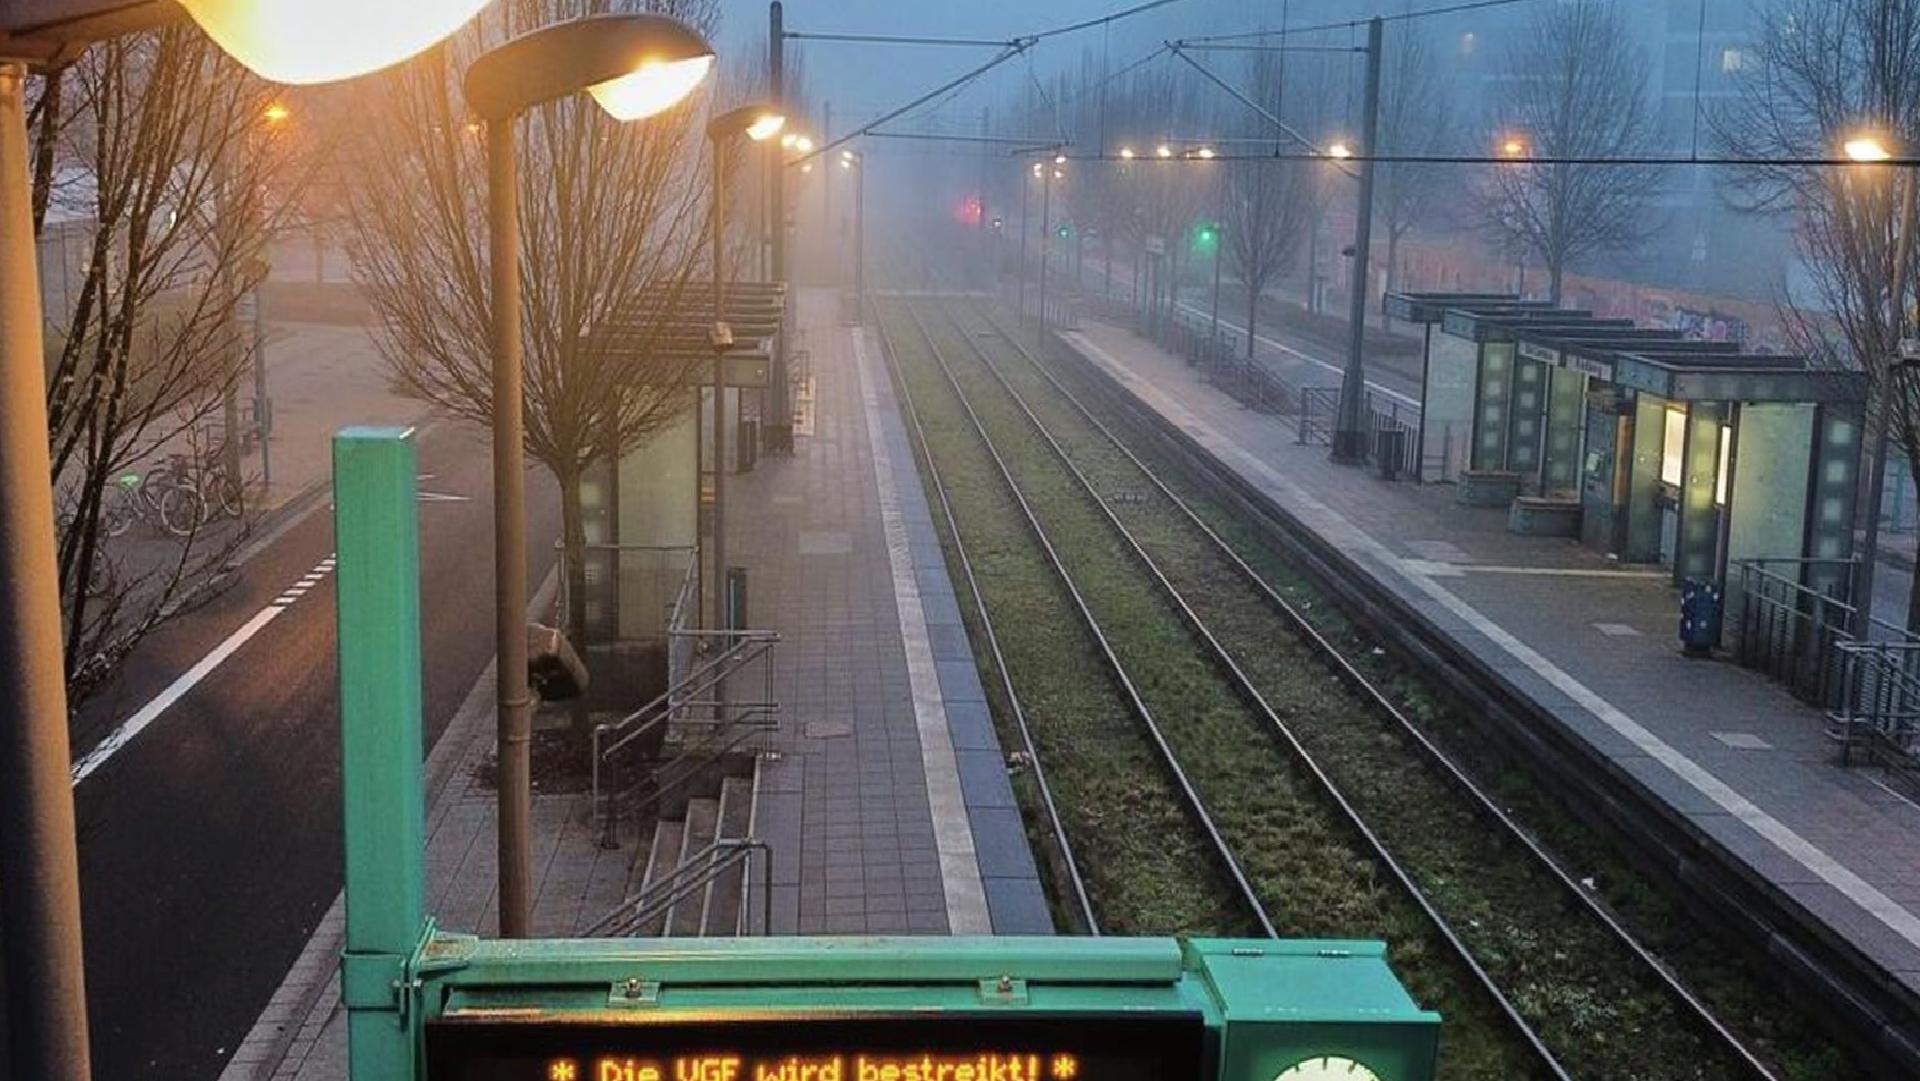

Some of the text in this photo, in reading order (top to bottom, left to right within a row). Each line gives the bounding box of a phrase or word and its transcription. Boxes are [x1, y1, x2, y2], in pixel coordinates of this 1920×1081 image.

[600, 1059, 660, 1081] Die
[676, 1057, 740, 1081] VGF
[756, 1056, 842, 1081] wird
[857, 1055, 1040, 1081] bestreikt!
